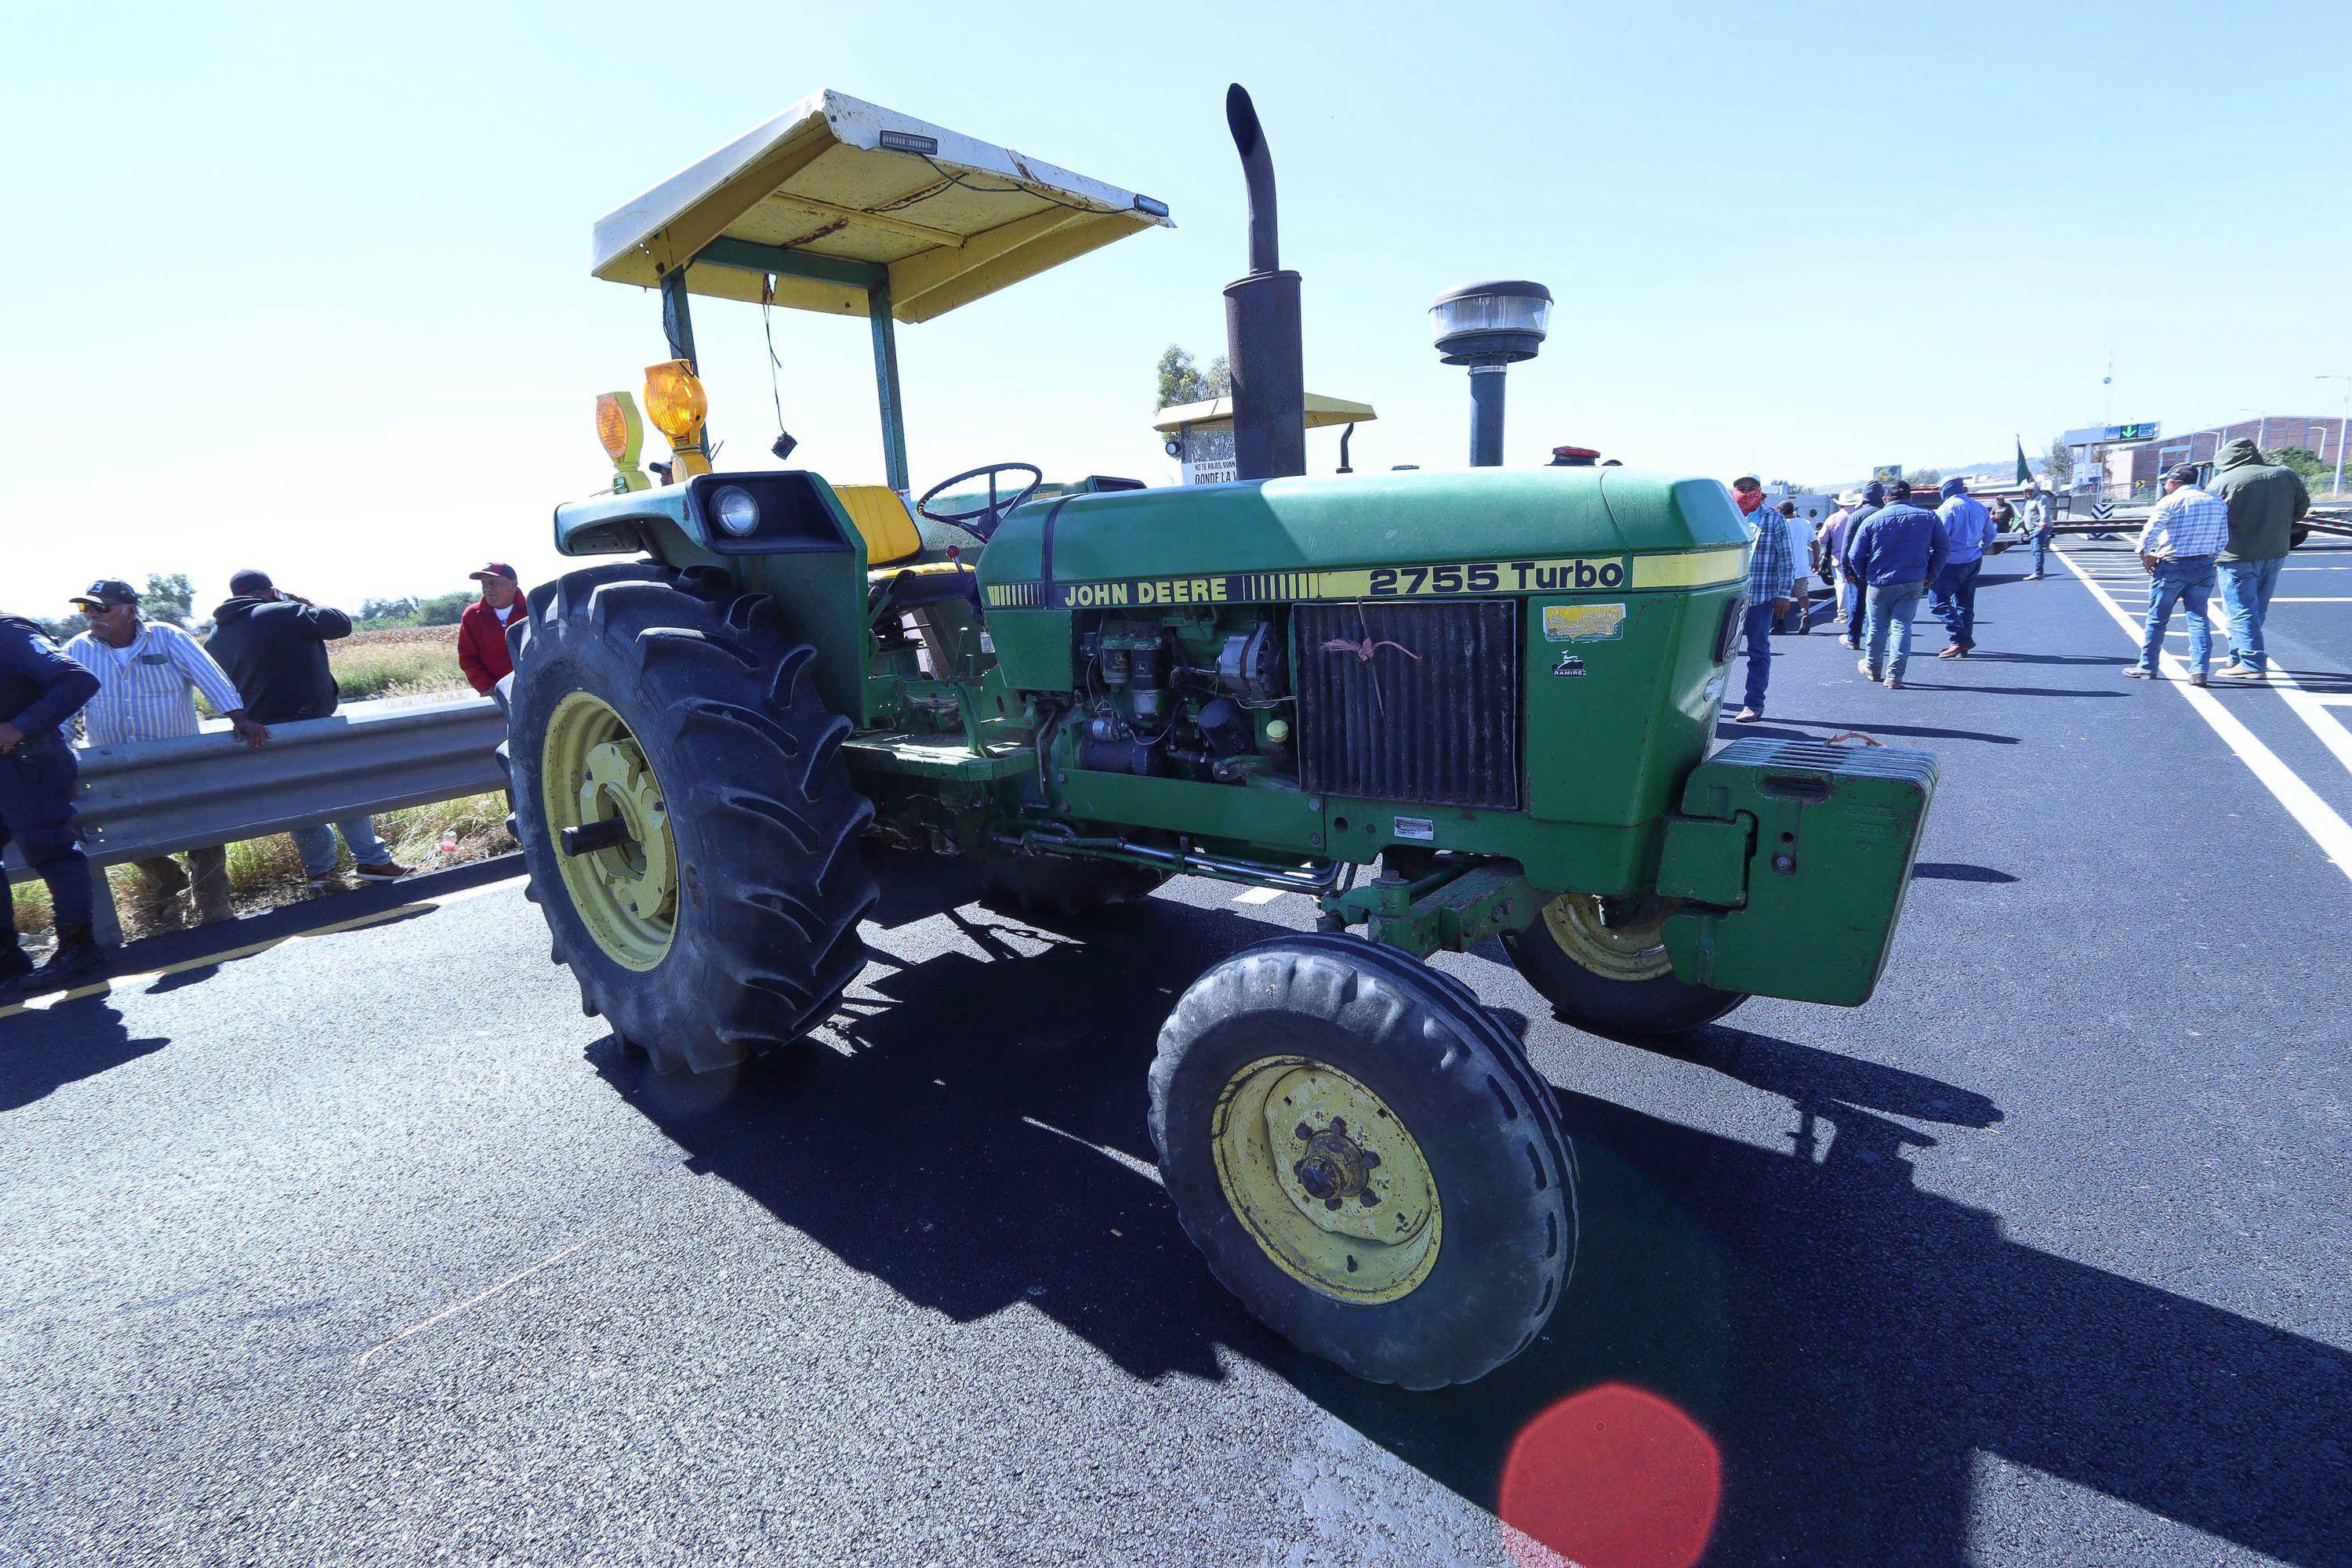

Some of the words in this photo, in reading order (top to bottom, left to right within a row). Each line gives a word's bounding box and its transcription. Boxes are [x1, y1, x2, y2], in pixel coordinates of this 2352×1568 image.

[1196, 472, 1219, 485] DONDE
[1221, 470, 1231, 483] LA
[1065, 583, 1128, 607] JOHN
[1138, 577, 1227, 604] DEERE
[1370, 564, 1499, 595] 2755
[1511, 559, 1624, 590] Turbo
